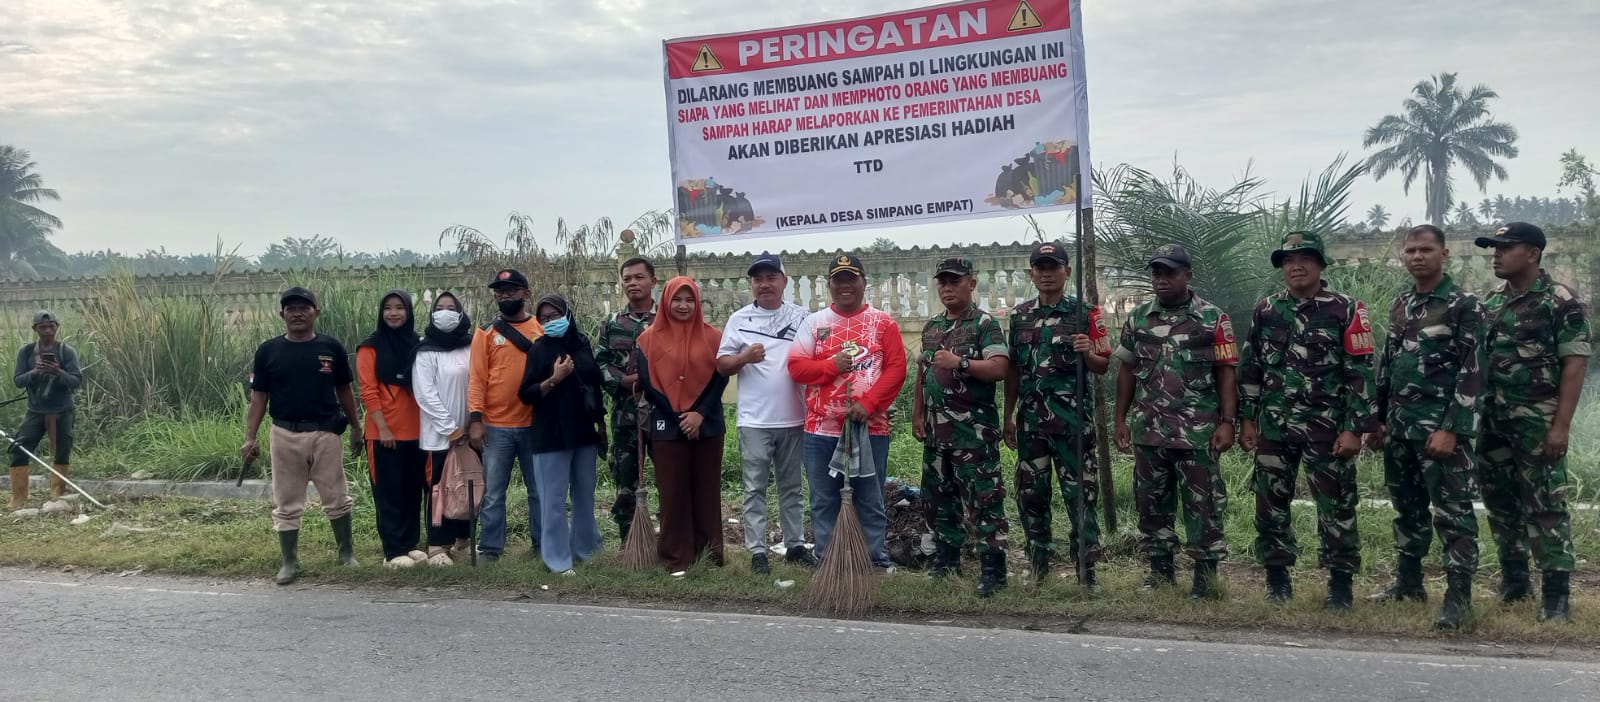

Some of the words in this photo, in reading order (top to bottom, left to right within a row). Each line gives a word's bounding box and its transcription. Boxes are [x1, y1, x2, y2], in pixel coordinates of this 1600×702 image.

[738, 7, 987, 66] PERINGATAN
[678, 82, 749, 104] DILARANG
[753, 71, 838, 97] MEMBUANG
[842, 62, 904, 86] SAMPAH
[909, 60, 925, 77] DI
[929, 45, 1036, 75] LINGKUNGAN
[1042, 41, 1064, 59] INI
[678, 107, 709, 123] SIAPA
[713, 102, 745, 119] YANG
[749, 97, 800, 115] MELIHAT
[804, 94, 828, 110] DAN
[832, 85, 900, 107] MEMPHOTO
[905, 79, 949, 97] ORANG
[952, 73, 987, 92] YANG
[991, 62, 1067, 87] MEMBUANG
[702, 123, 749, 141] SAMPAH
[752, 118, 792, 136] HARAP
[796, 110, 879, 131] MELAPORKAN
[883, 106, 900, 121] KE
[903, 94, 1002, 119] PEMERINTAHAN
[1007, 89, 1041, 106] DESA
[728, 141, 770, 160] AKAN
[774, 132, 858, 155] DIBERIKAN
[863, 122, 946, 146] APRESIASI
[952, 114, 1015, 136] HADIAH
[853, 159, 883, 174] TTD
[776, 213, 828, 230] (KEPALA
[830, 209, 863, 223] DESA
[866, 203, 923, 220] SIMPANG
[927, 198, 974, 214] EMPAT)
